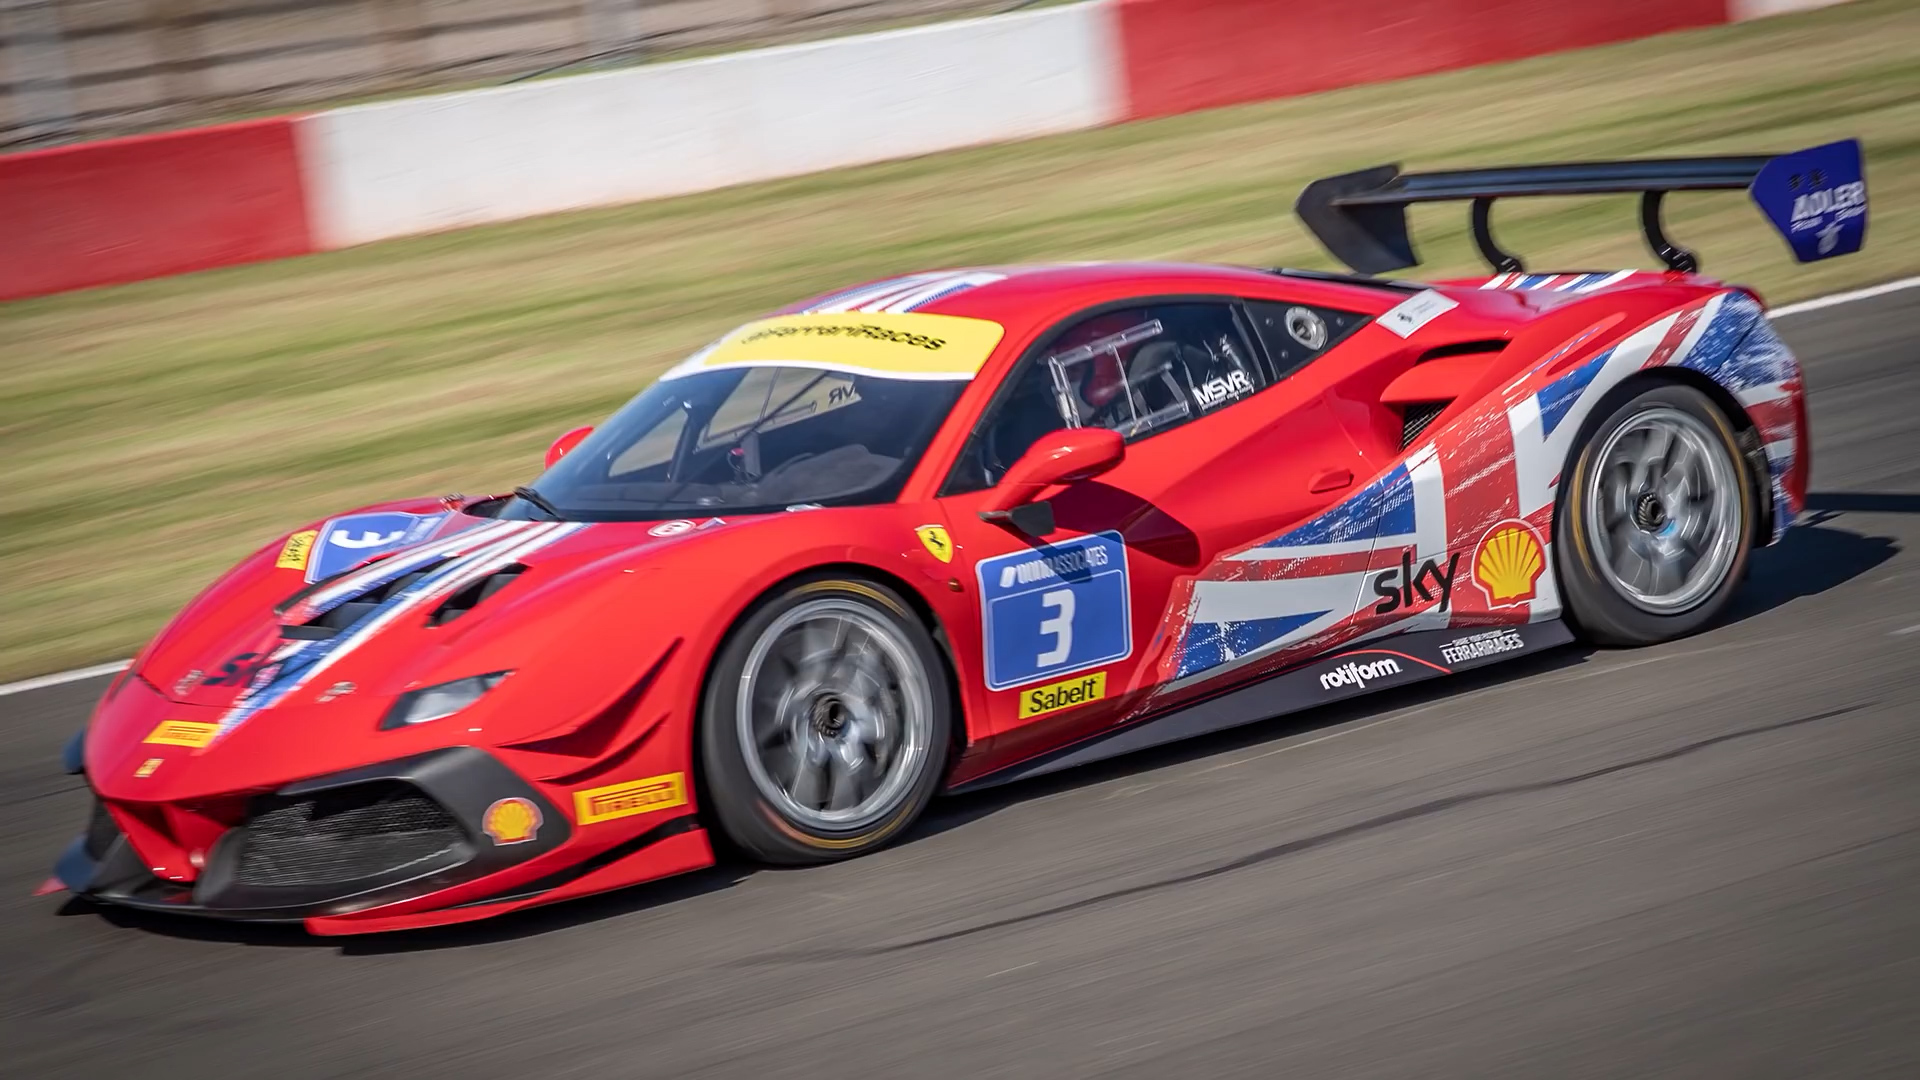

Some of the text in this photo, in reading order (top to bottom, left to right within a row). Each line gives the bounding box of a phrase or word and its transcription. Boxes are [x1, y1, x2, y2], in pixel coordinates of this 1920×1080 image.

[1192, 370, 1250, 407] MSVR
[1373, 551, 1460, 615] sky
[1037, 588, 1075, 668] 3
[1441, 633, 1525, 664] FERRARIRACES
[1319, 658, 1402, 689] rotiform
[1030, 678, 1096, 713] Sabelt
